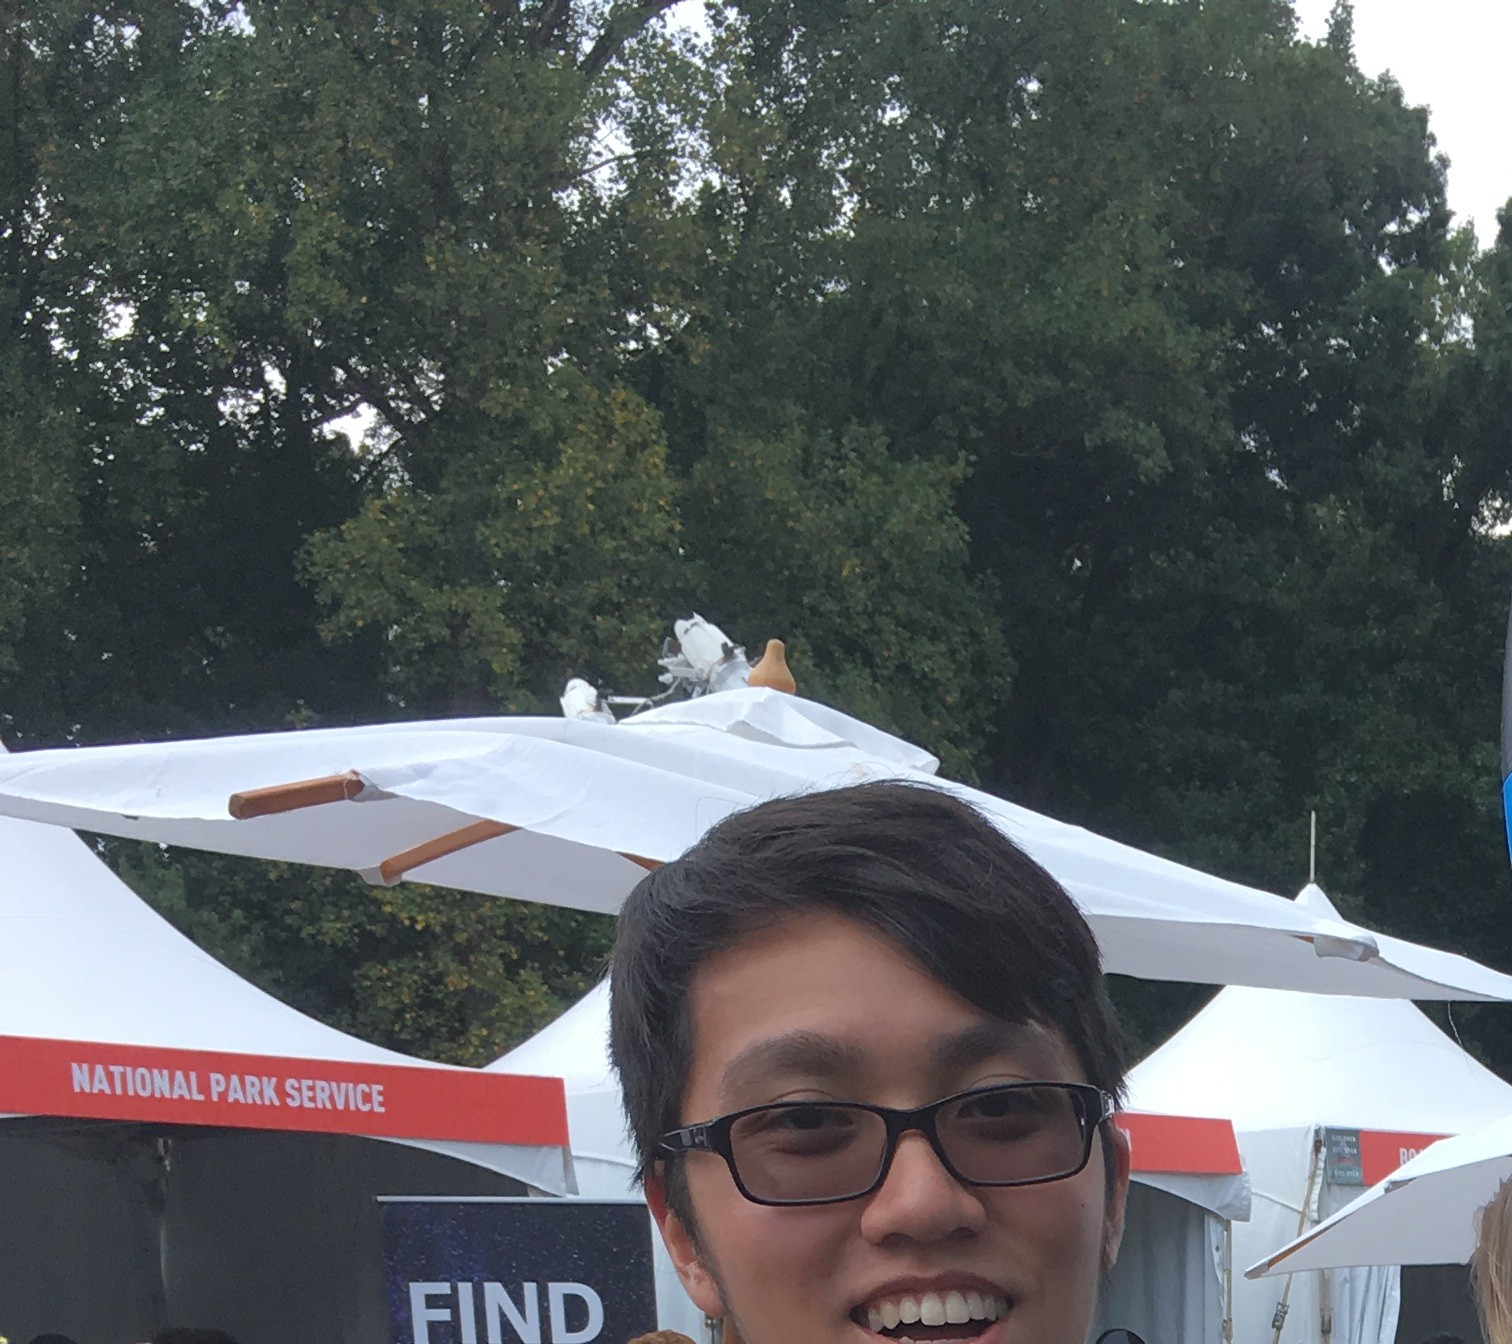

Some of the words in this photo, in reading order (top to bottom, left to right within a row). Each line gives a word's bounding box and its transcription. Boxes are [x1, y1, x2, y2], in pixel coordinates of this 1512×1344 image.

[70, 1062, 205, 1101] NATIONAL
[209, 1072, 280, 1106] PARK
[285, 1078, 386, 1113] SERVICE
